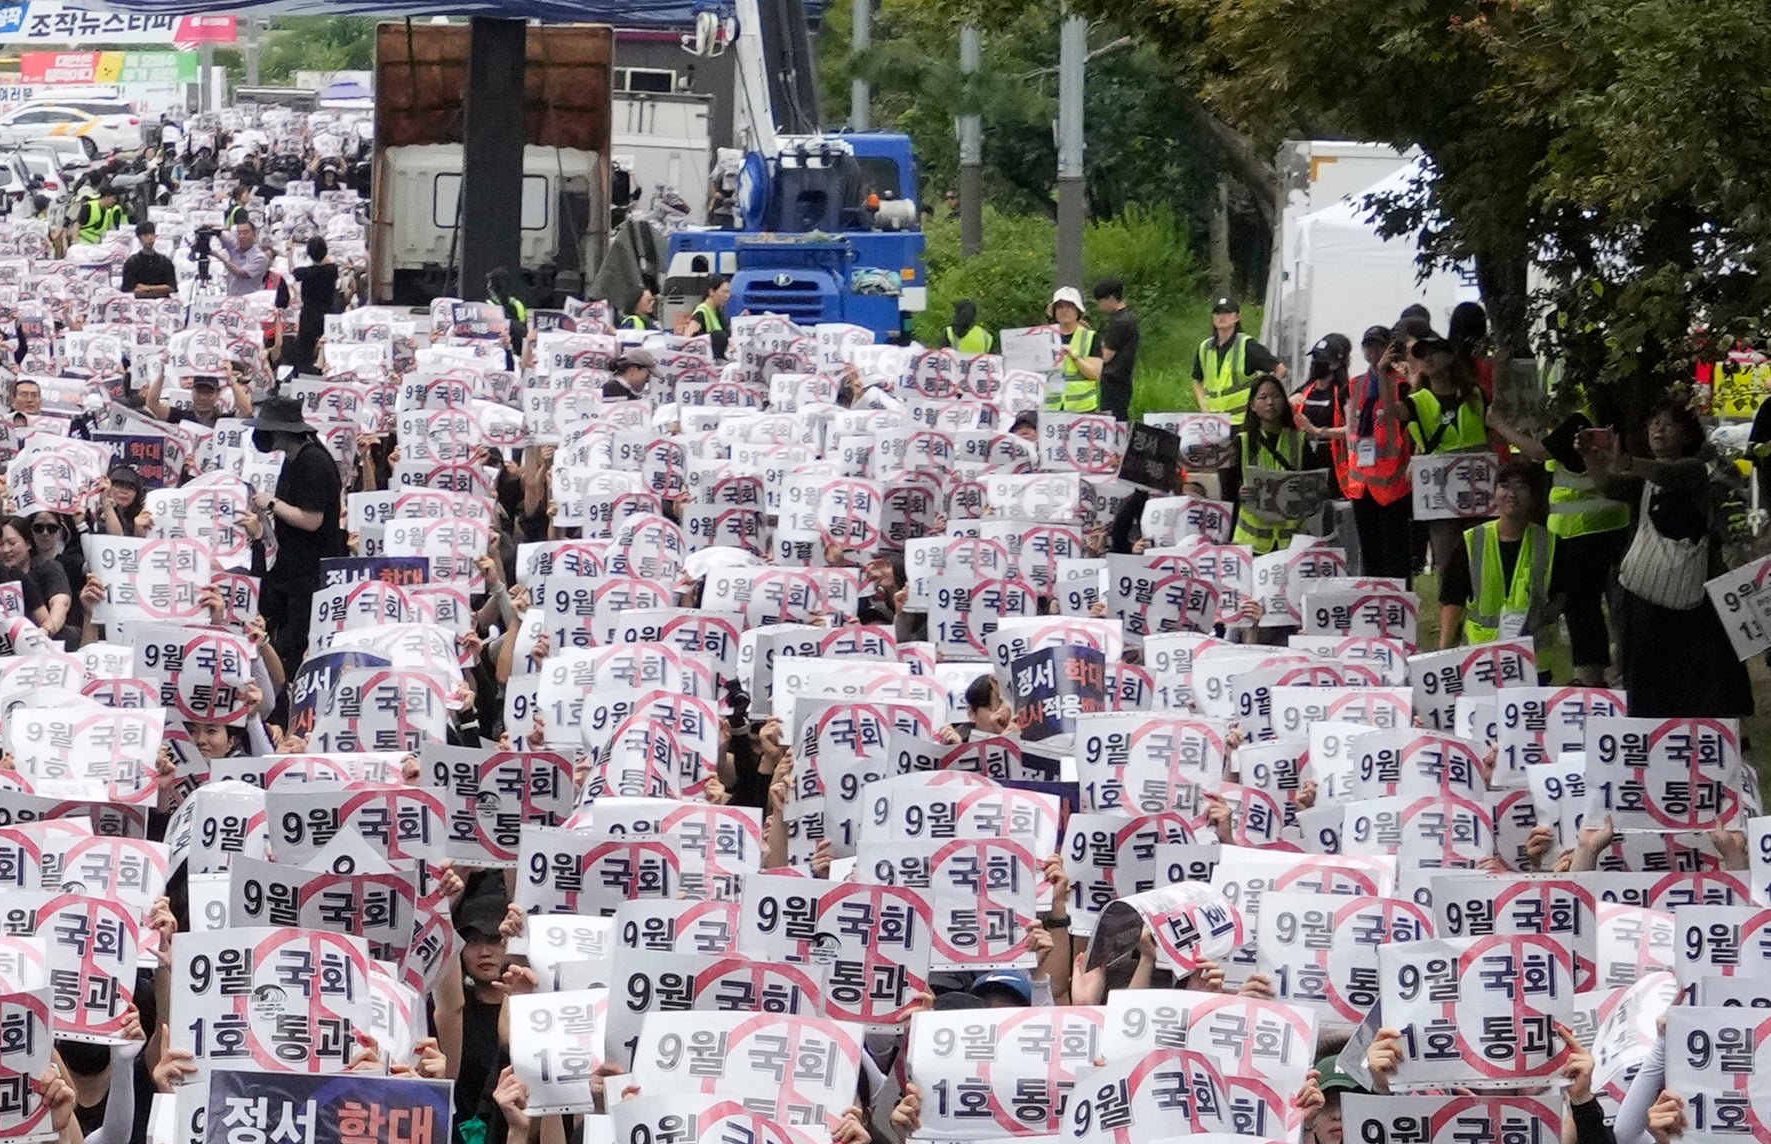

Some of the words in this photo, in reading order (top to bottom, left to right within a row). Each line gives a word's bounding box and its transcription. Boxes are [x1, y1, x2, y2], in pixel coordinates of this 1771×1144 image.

[28, 13, 176, 37] 조작뉴스타파
[454, 304, 479, 321] 정서
[536, 315, 561, 330] 정서
[403, 419, 429, 435] 9월
[437, 418, 471, 438] 국회
[1046, 424, 1070, 441] 9월
[1077, 424, 1108, 442] 국회
[1046, 446, 1068, 462] 1호
[1315, 605, 1352, 630] 9월
[1363, 604, 1407, 630] 국회
[144, 644, 184, 670] 9월
[196, 645, 241, 677] 국회
[1016, 659, 1056, 698] 정서
[1064, 657, 1103, 692] 학대
[1422, 665, 1464, 697] 9월
[1474, 655, 1526, 688] 국회
[189, 685, 238, 710] 통과
[293, 667, 331, 705] 정서
[1597, 733, 1651, 770] 9월
[1665, 732, 1726, 770] 국회
[1599, 780, 1648, 815] 1호
[1660, 782, 1726, 816] 통과
[529, 852, 582, 892] 9월
[600, 858, 669, 896] 국회
[948, 855, 1019, 894] 국회
[947, 908, 1018, 947] 통과
[188, 1013, 251, 1060] 1호
[271, 1011, 357, 1066] 통과
[1400, 1019, 1463, 1062] 1호
[1480, 1015, 1560, 1062] 통과
